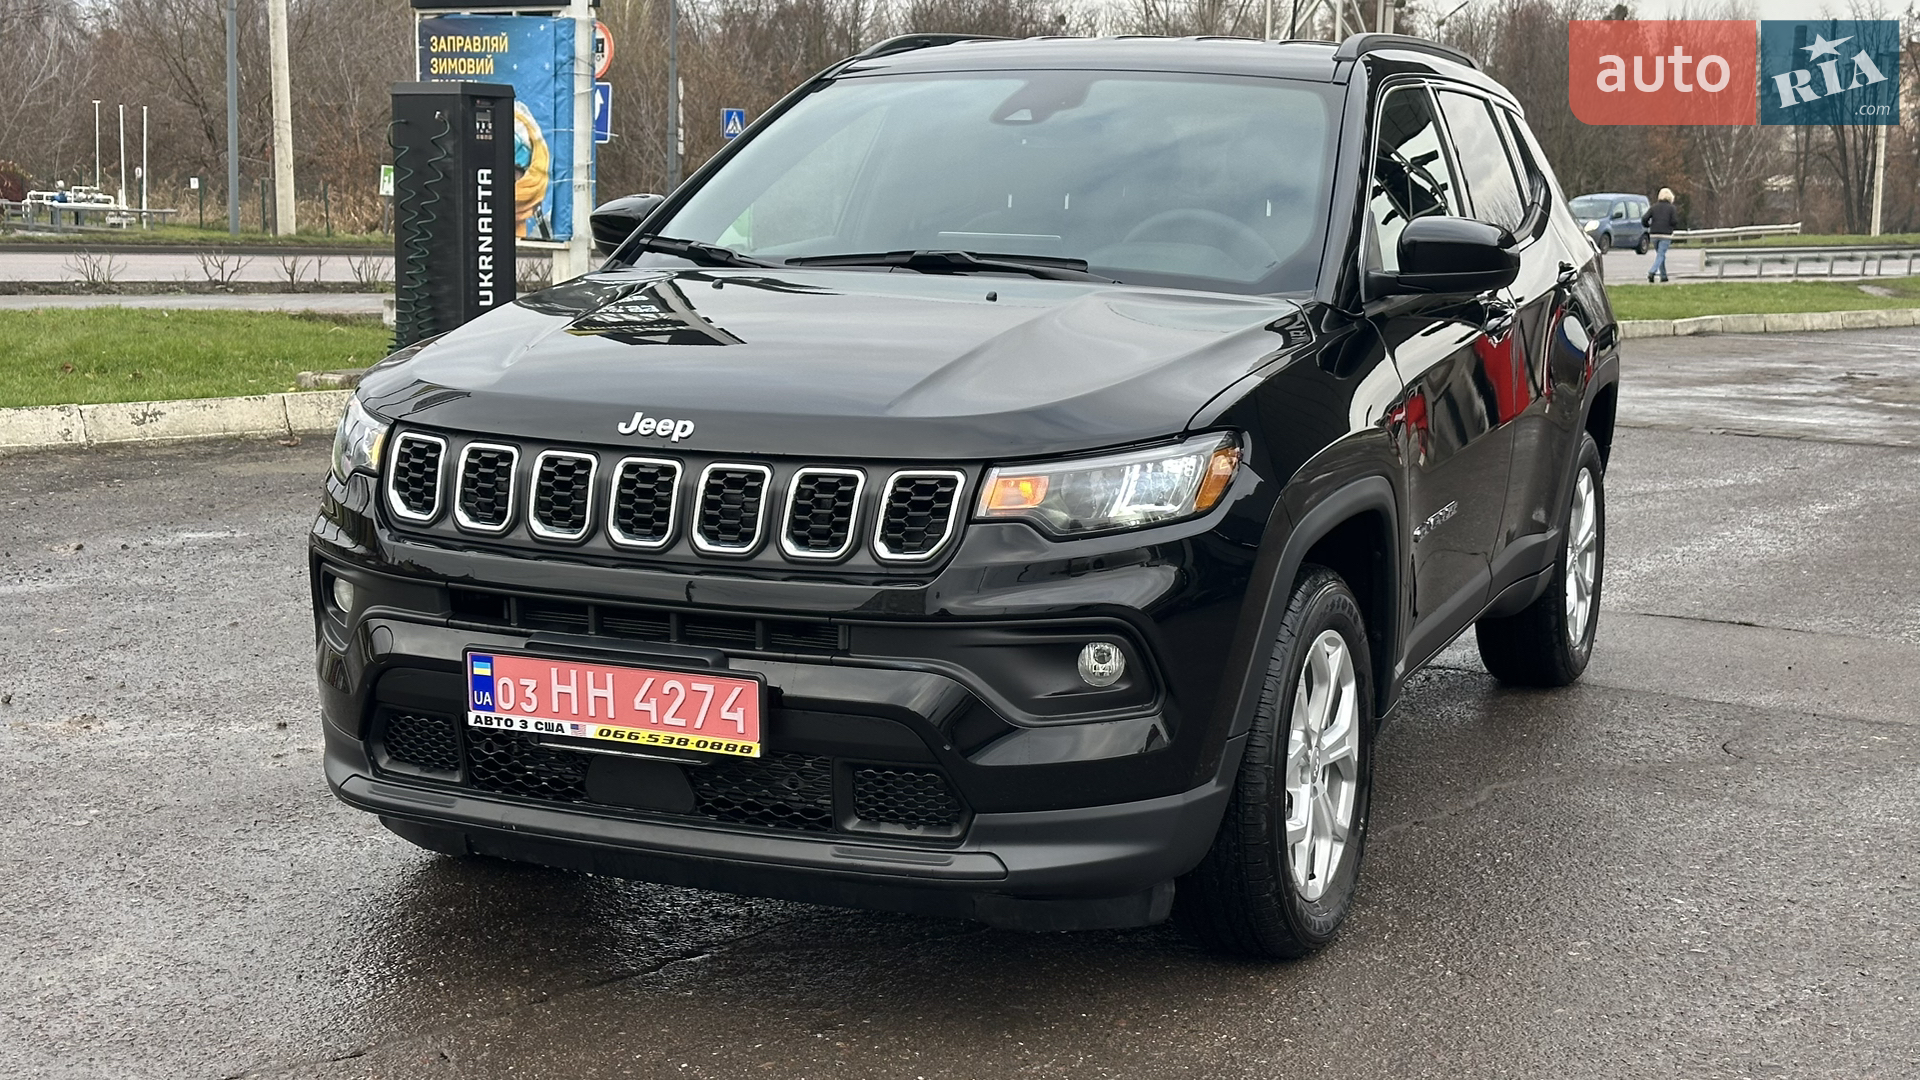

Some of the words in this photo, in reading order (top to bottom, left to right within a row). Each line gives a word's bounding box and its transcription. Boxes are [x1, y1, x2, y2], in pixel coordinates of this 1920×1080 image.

[430, 32, 509, 53] ЗАПРАВЛЯЙ
[430, 54, 494, 75] ЗИМОВИЙ
[477, 168, 494, 307] UKRNAFTA
[617, 411, 695, 443] Jeep
[473, 690, 493, 707] UA
[496, 676, 539, 713] 03
[549, 666, 616, 719] HH
[633, 676, 747, 734] 4274
[473, 714, 515, 729] АВТО
[534, 721, 565, 734] США
[598, 728, 754, 755] 066-538-0888
